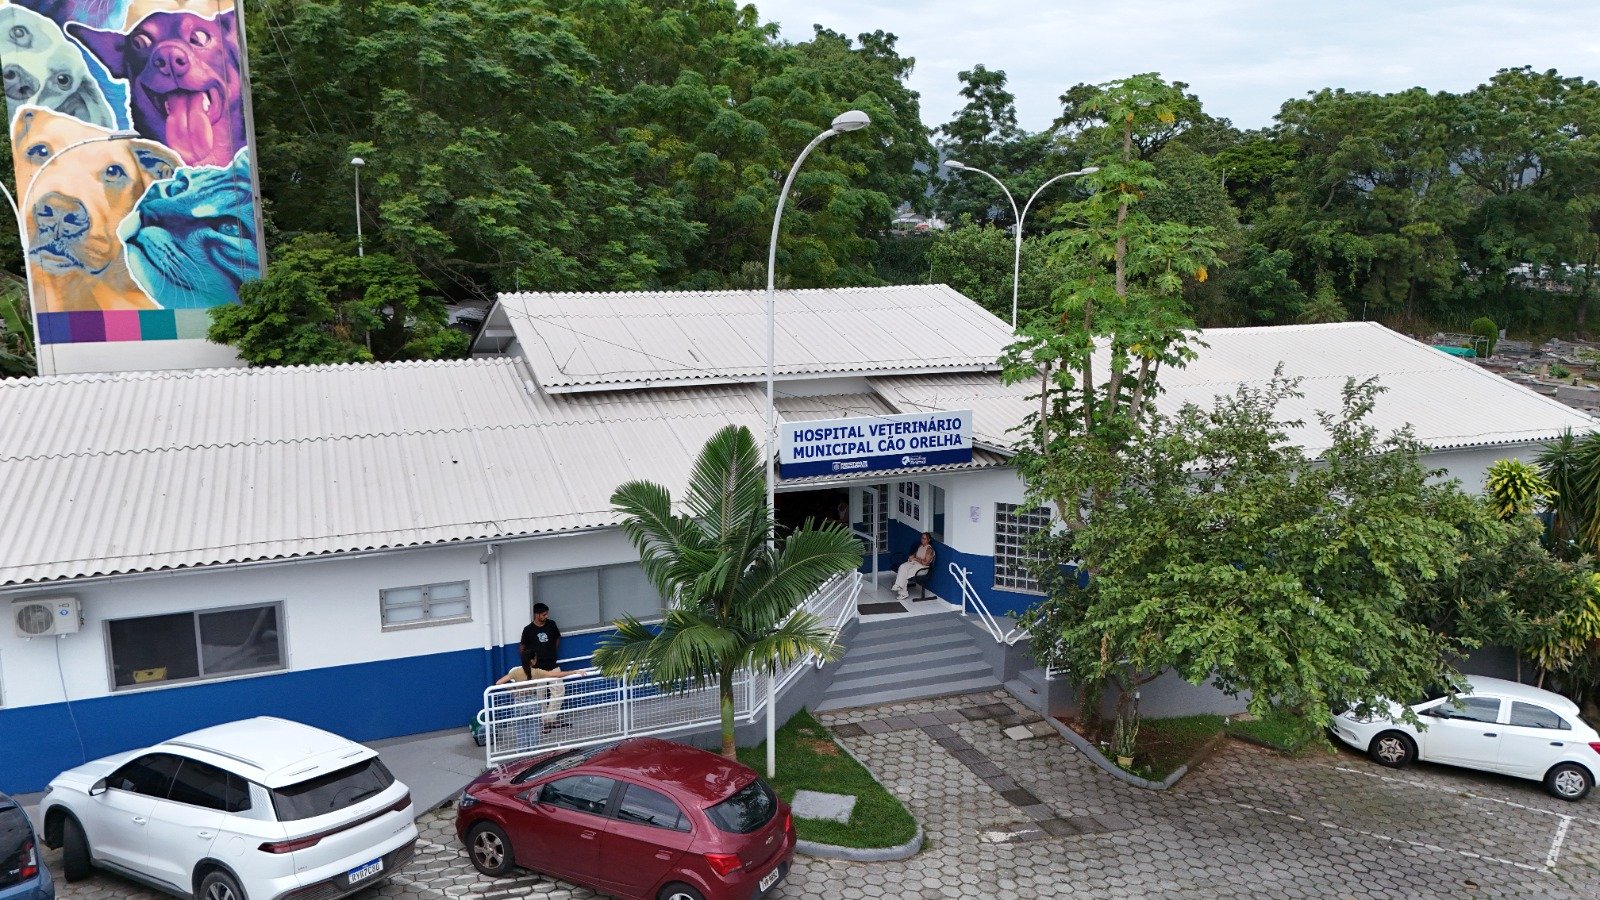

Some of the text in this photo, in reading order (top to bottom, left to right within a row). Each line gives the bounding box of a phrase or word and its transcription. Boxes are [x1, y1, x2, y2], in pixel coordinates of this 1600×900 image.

[794, 416, 962, 442] HOSPITAL VETERINÁRIO
[793, 433, 962, 459] MUNICIPAL CÃO ORELHA
